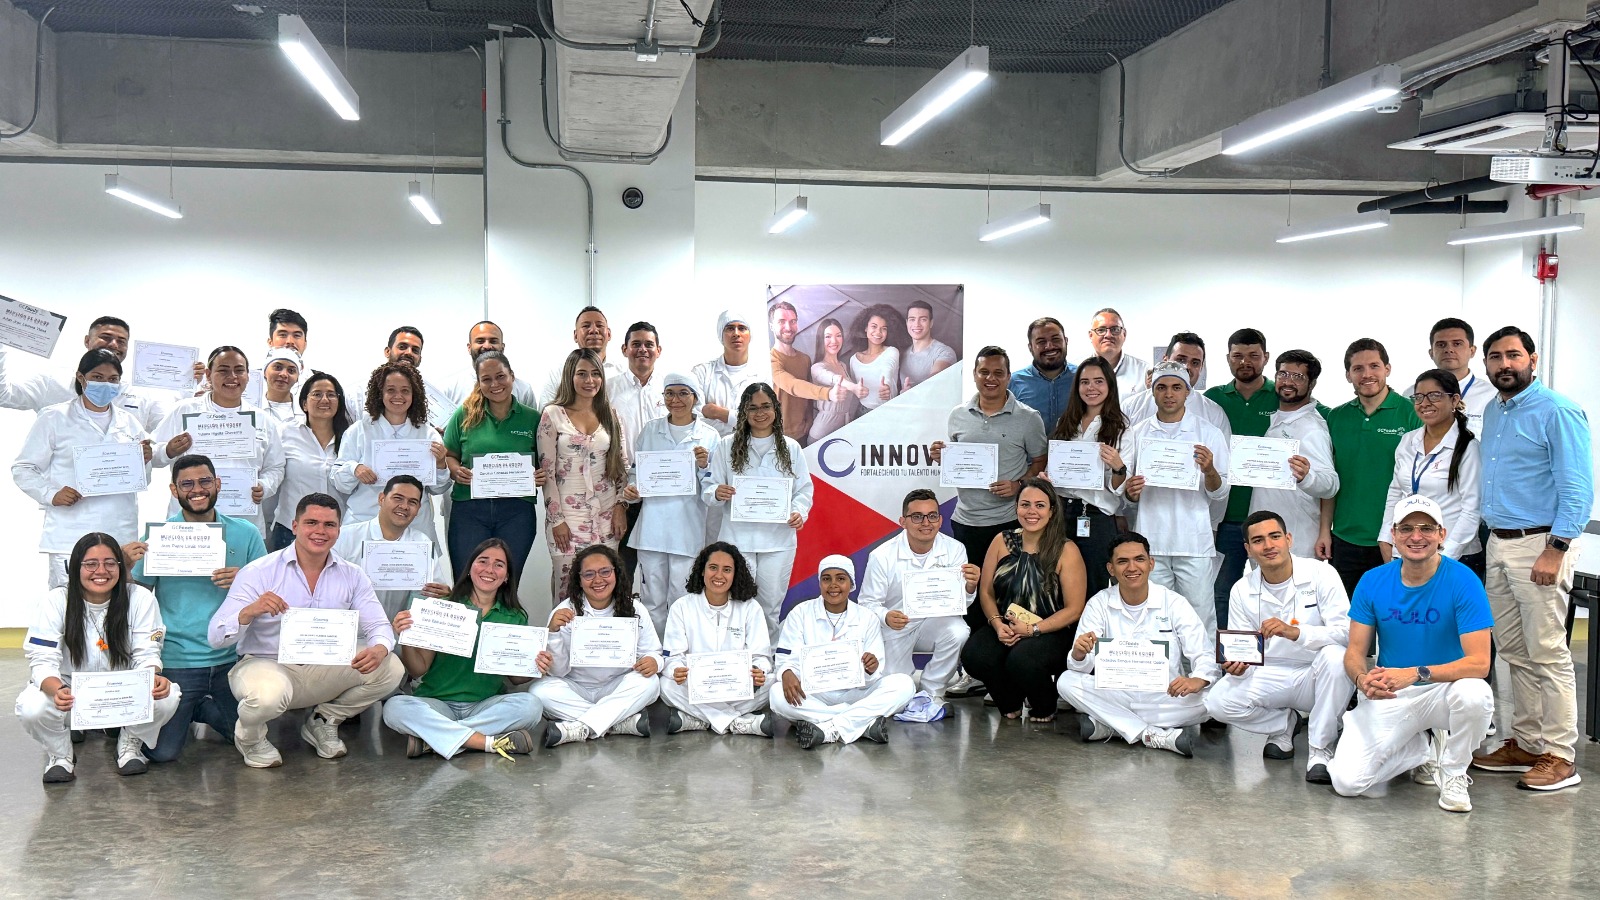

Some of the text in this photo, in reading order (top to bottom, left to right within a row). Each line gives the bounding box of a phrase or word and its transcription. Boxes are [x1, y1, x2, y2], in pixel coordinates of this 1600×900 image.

[861, 444, 941, 466] INNOV
[860, 468, 900, 476] FORTALECIENDO
[901, 468, 907, 476] TU
[908, 468, 930, 476] TALENTO
